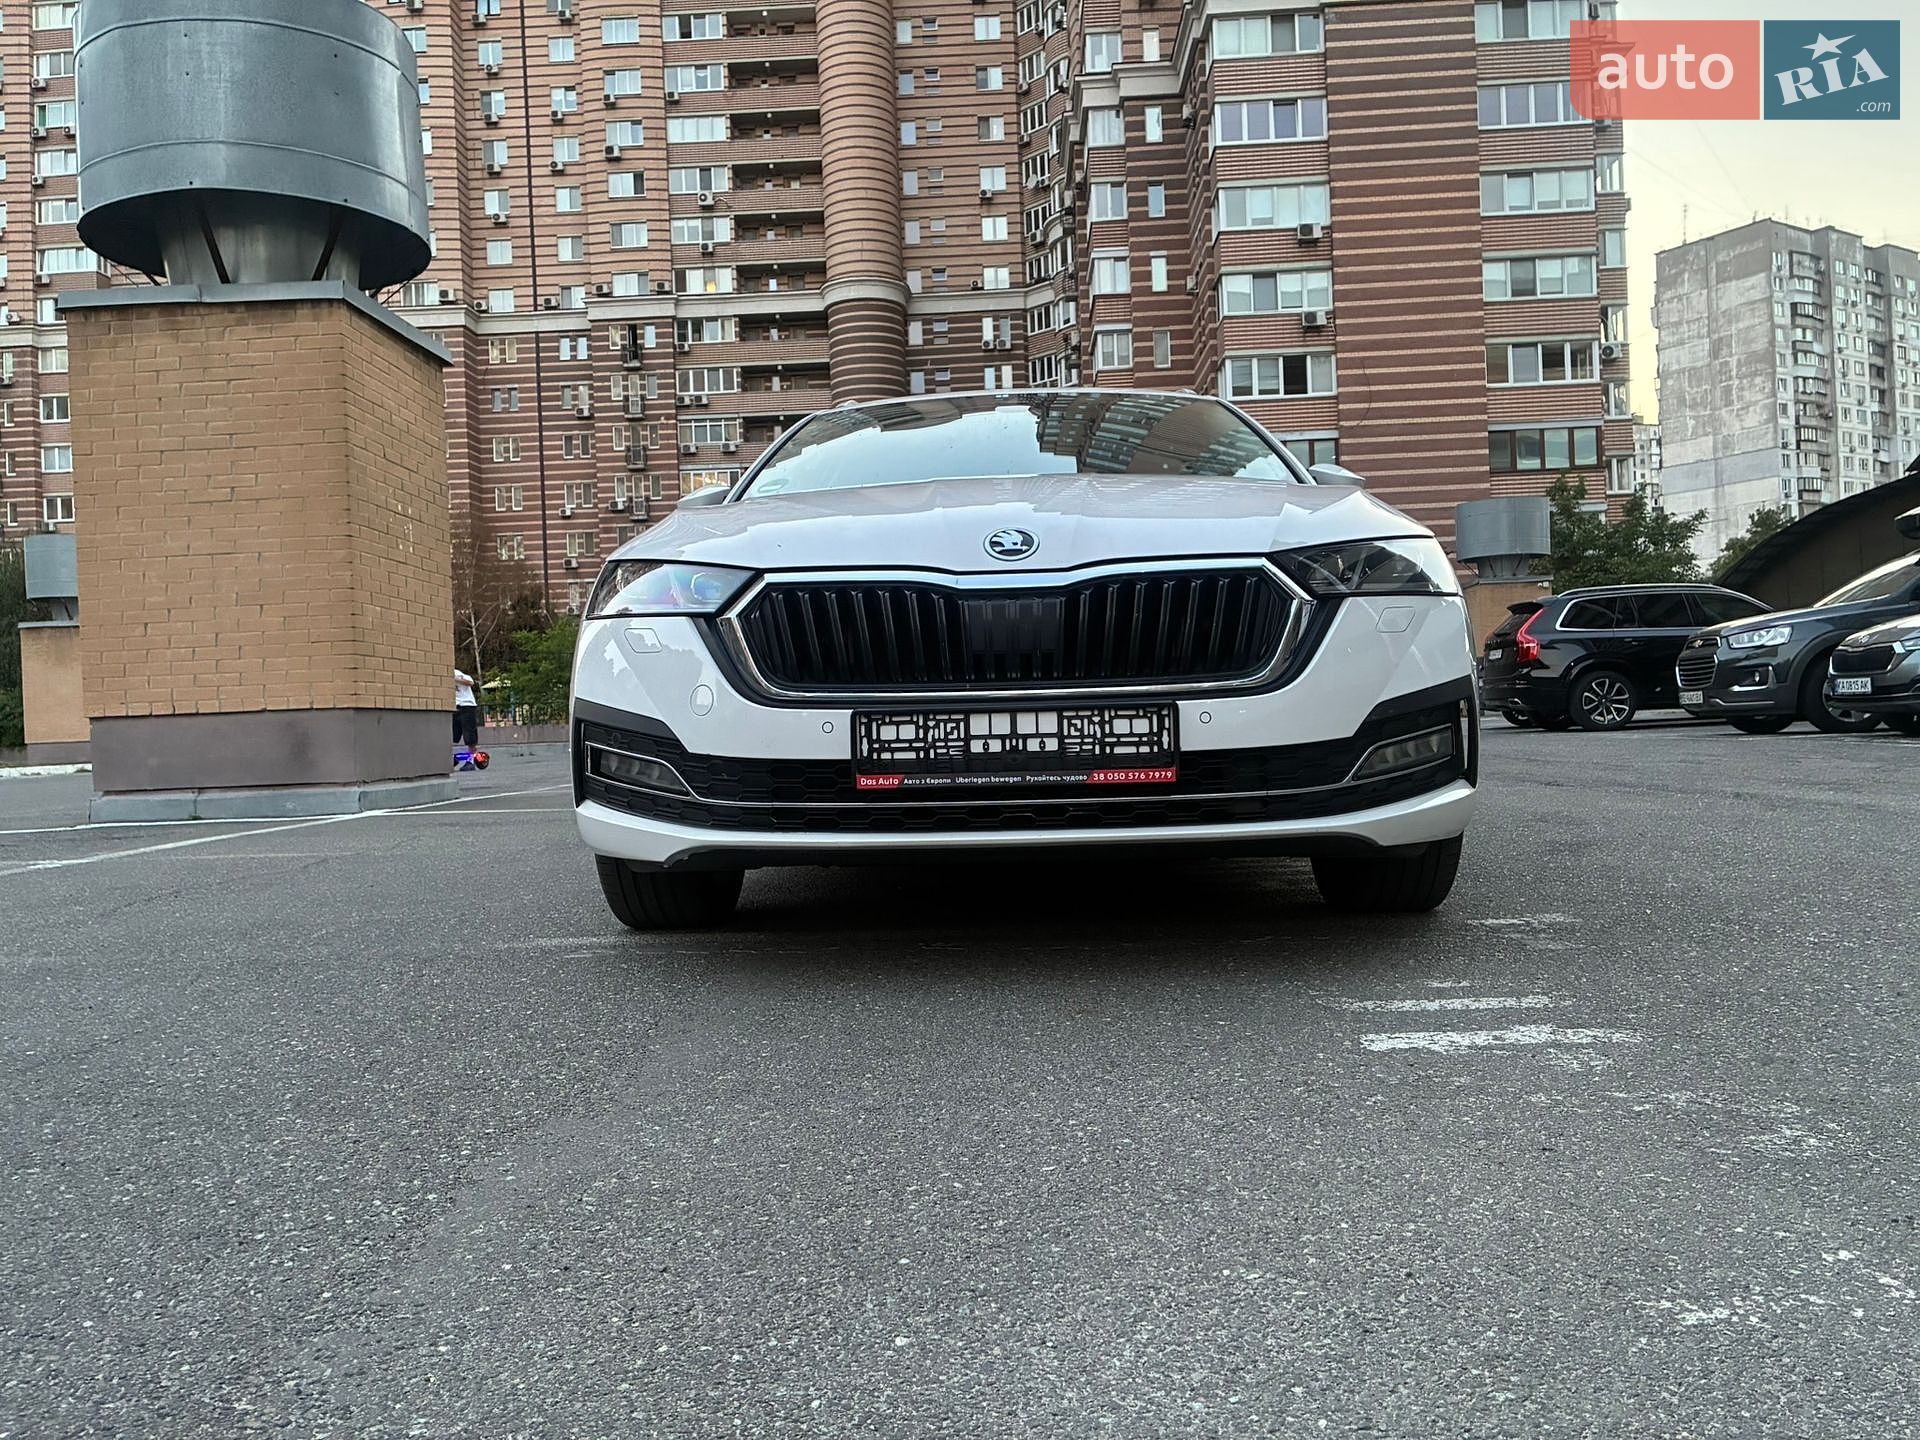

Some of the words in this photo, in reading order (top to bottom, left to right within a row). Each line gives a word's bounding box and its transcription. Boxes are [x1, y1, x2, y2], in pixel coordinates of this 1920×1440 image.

[1093, 773, 1105, 781] 38
[1107, 772, 1126, 780] 050
[1128, 771, 1146, 780] 576
[1148, 771, 1172, 779] 7979
[860, 777, 876, 786] Das
[878, 777, 899, 785] Auto
